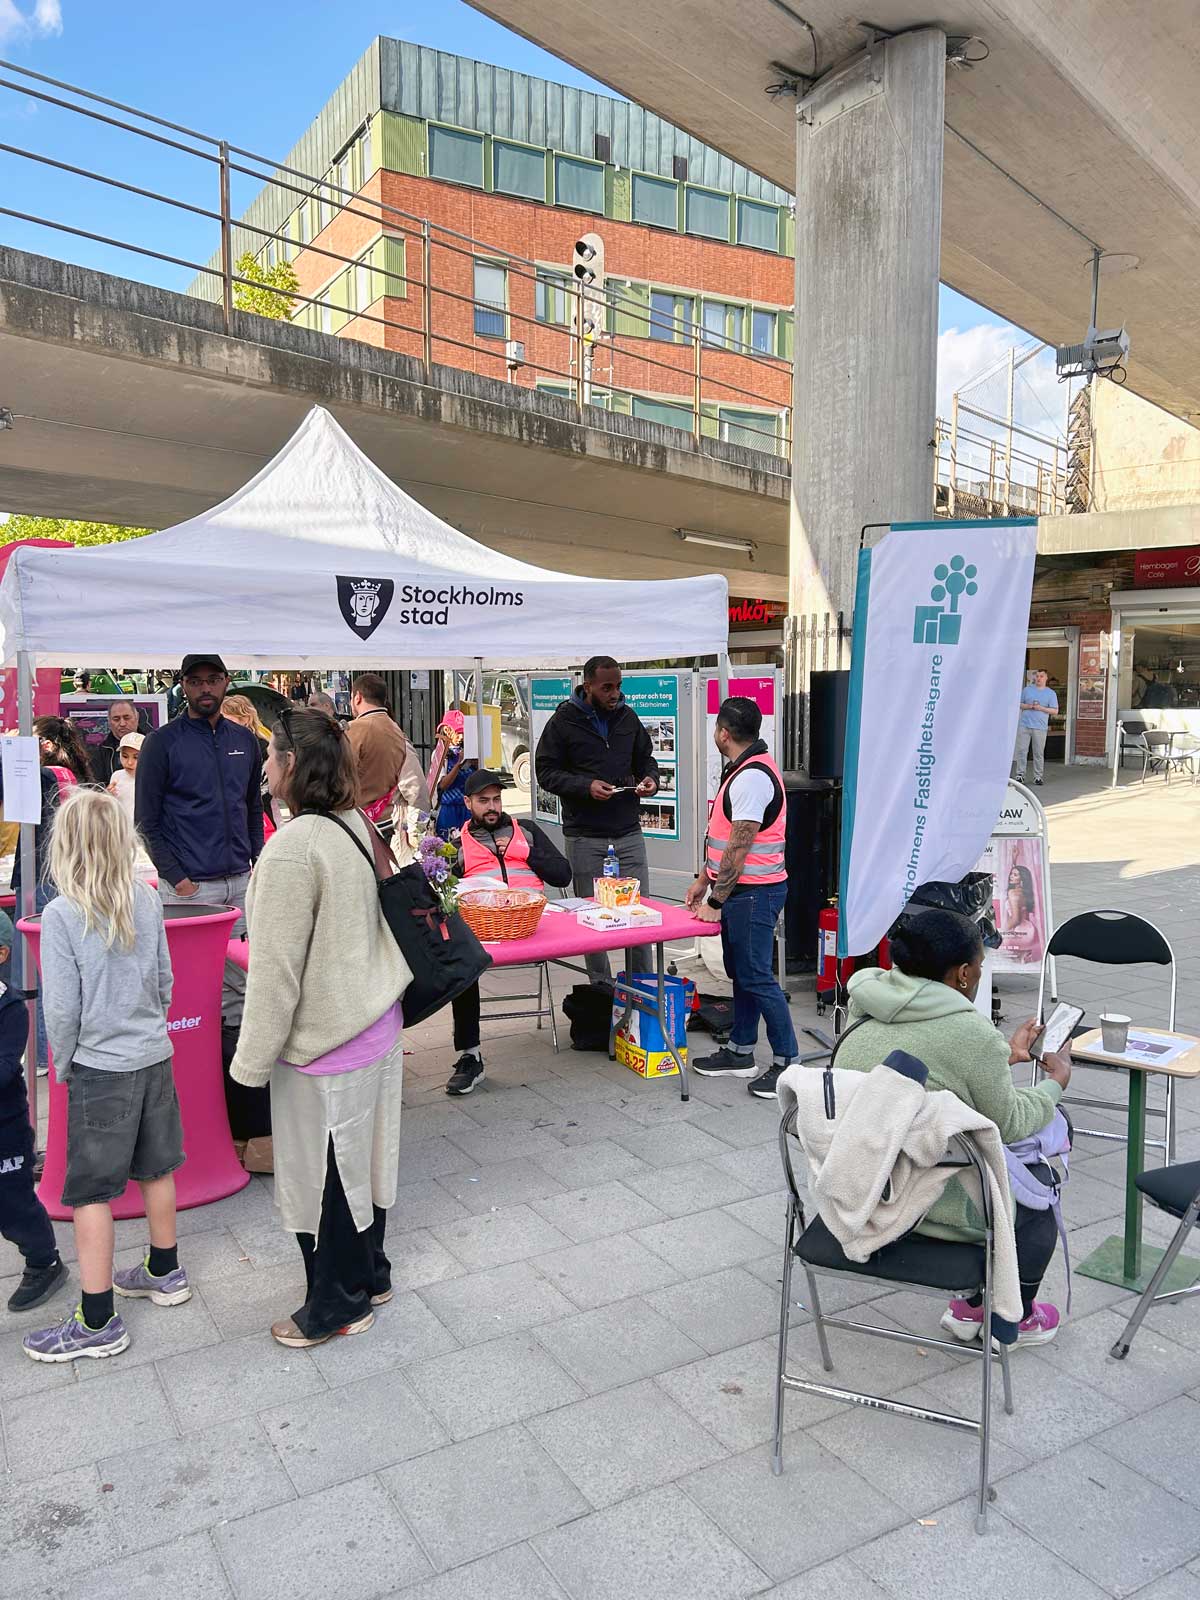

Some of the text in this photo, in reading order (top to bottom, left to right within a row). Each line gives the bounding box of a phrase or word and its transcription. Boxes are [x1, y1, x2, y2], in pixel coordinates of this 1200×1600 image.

[400, 585, 524, 606] Stockholms
[400, 606, 449, 625] stad
[914, 654, 943, 809] Fastighetsägare
